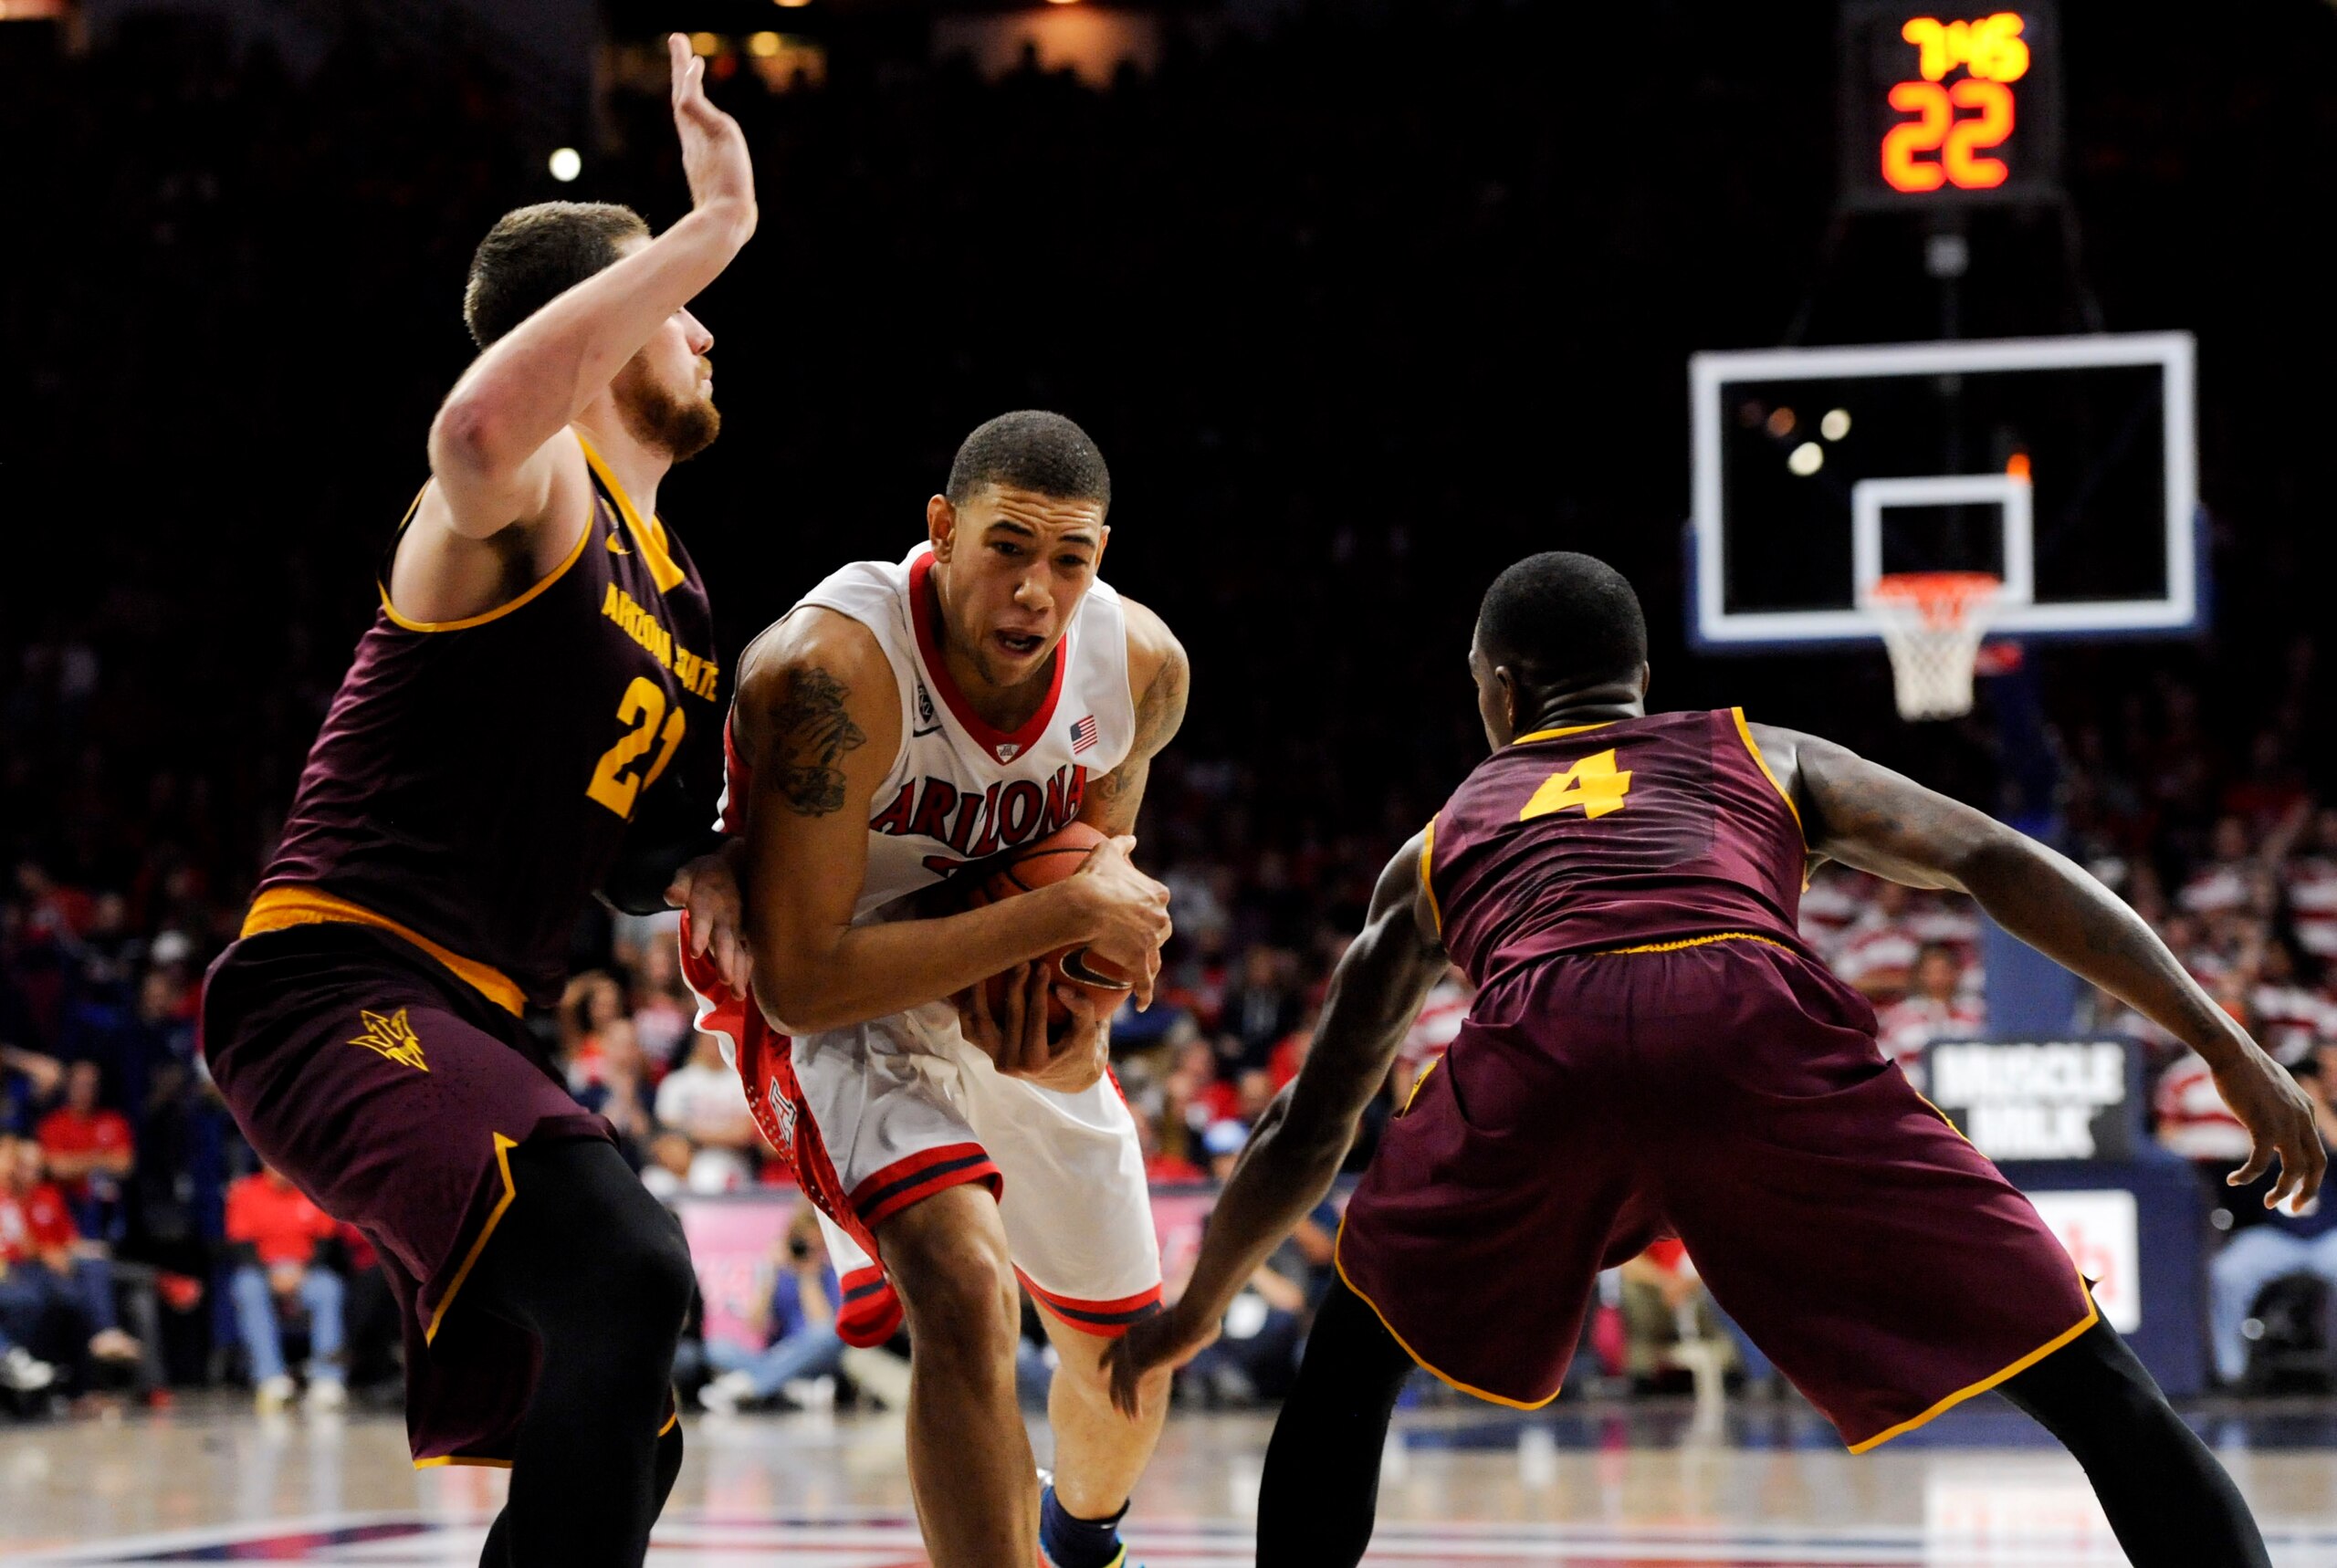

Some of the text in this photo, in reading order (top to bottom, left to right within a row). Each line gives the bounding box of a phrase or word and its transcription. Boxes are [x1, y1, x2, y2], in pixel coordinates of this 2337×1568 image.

[1881, 79, 2015, 193] 22
[869, 763, 1088, 858] ARIZONA
[1519, 747, 1633, 822] 4
